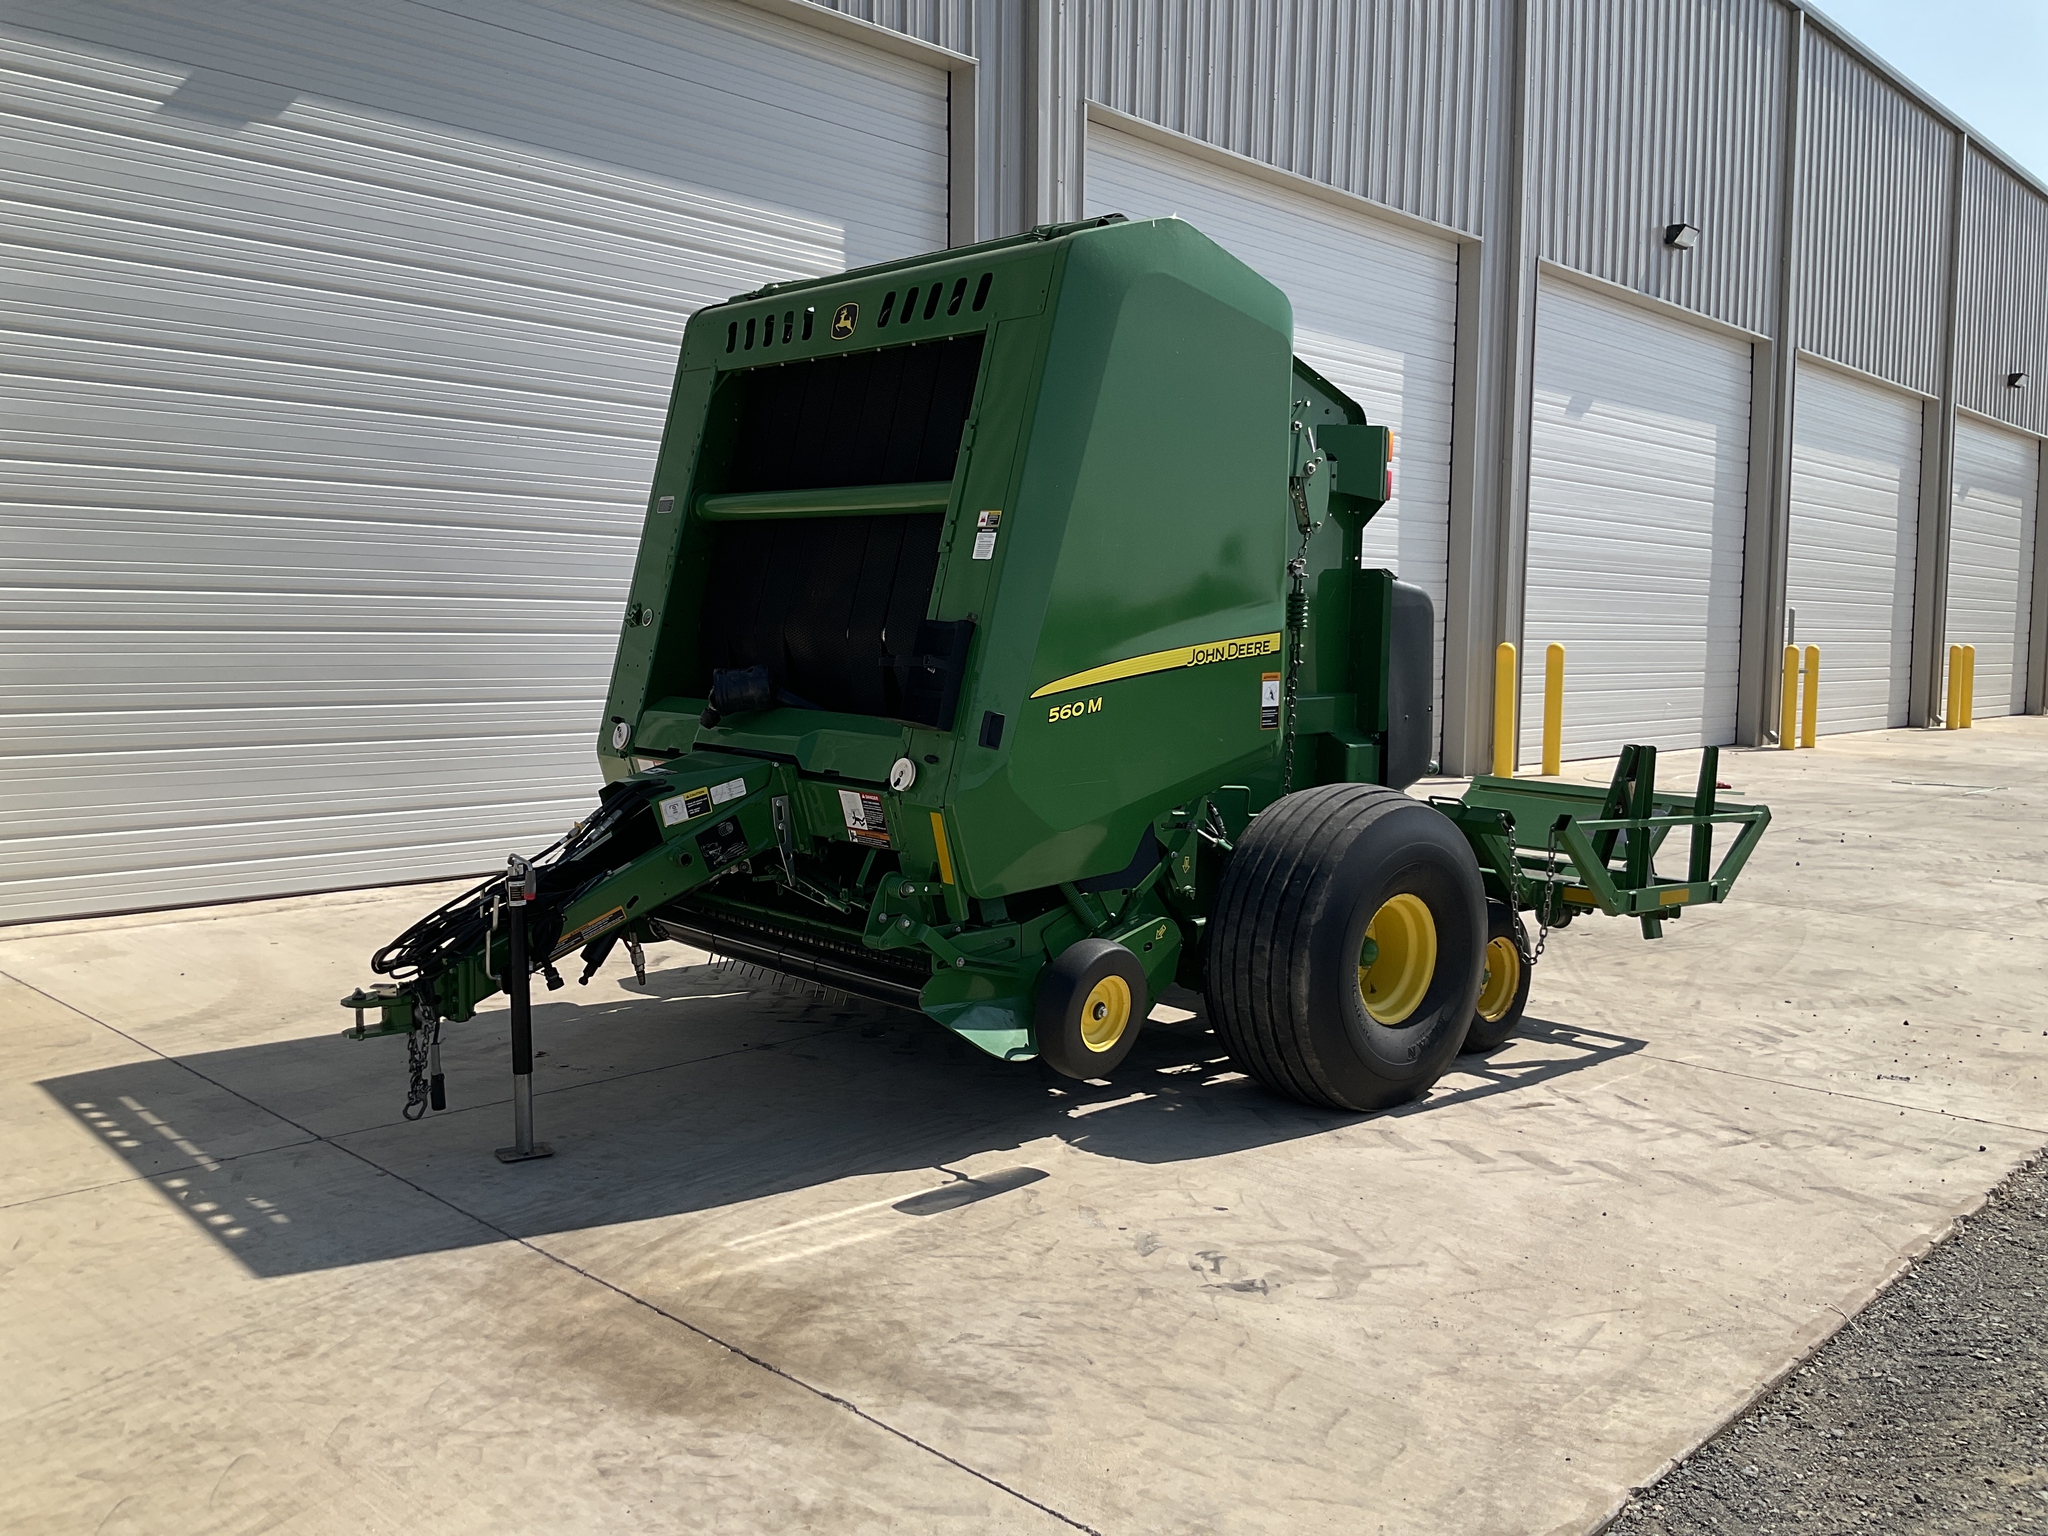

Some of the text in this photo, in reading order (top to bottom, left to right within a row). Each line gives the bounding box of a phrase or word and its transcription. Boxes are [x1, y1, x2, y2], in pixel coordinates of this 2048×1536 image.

[1187, 640, 1271, 665] JOHN DEERE
[1048, 696, 1103, 723] 560 M
